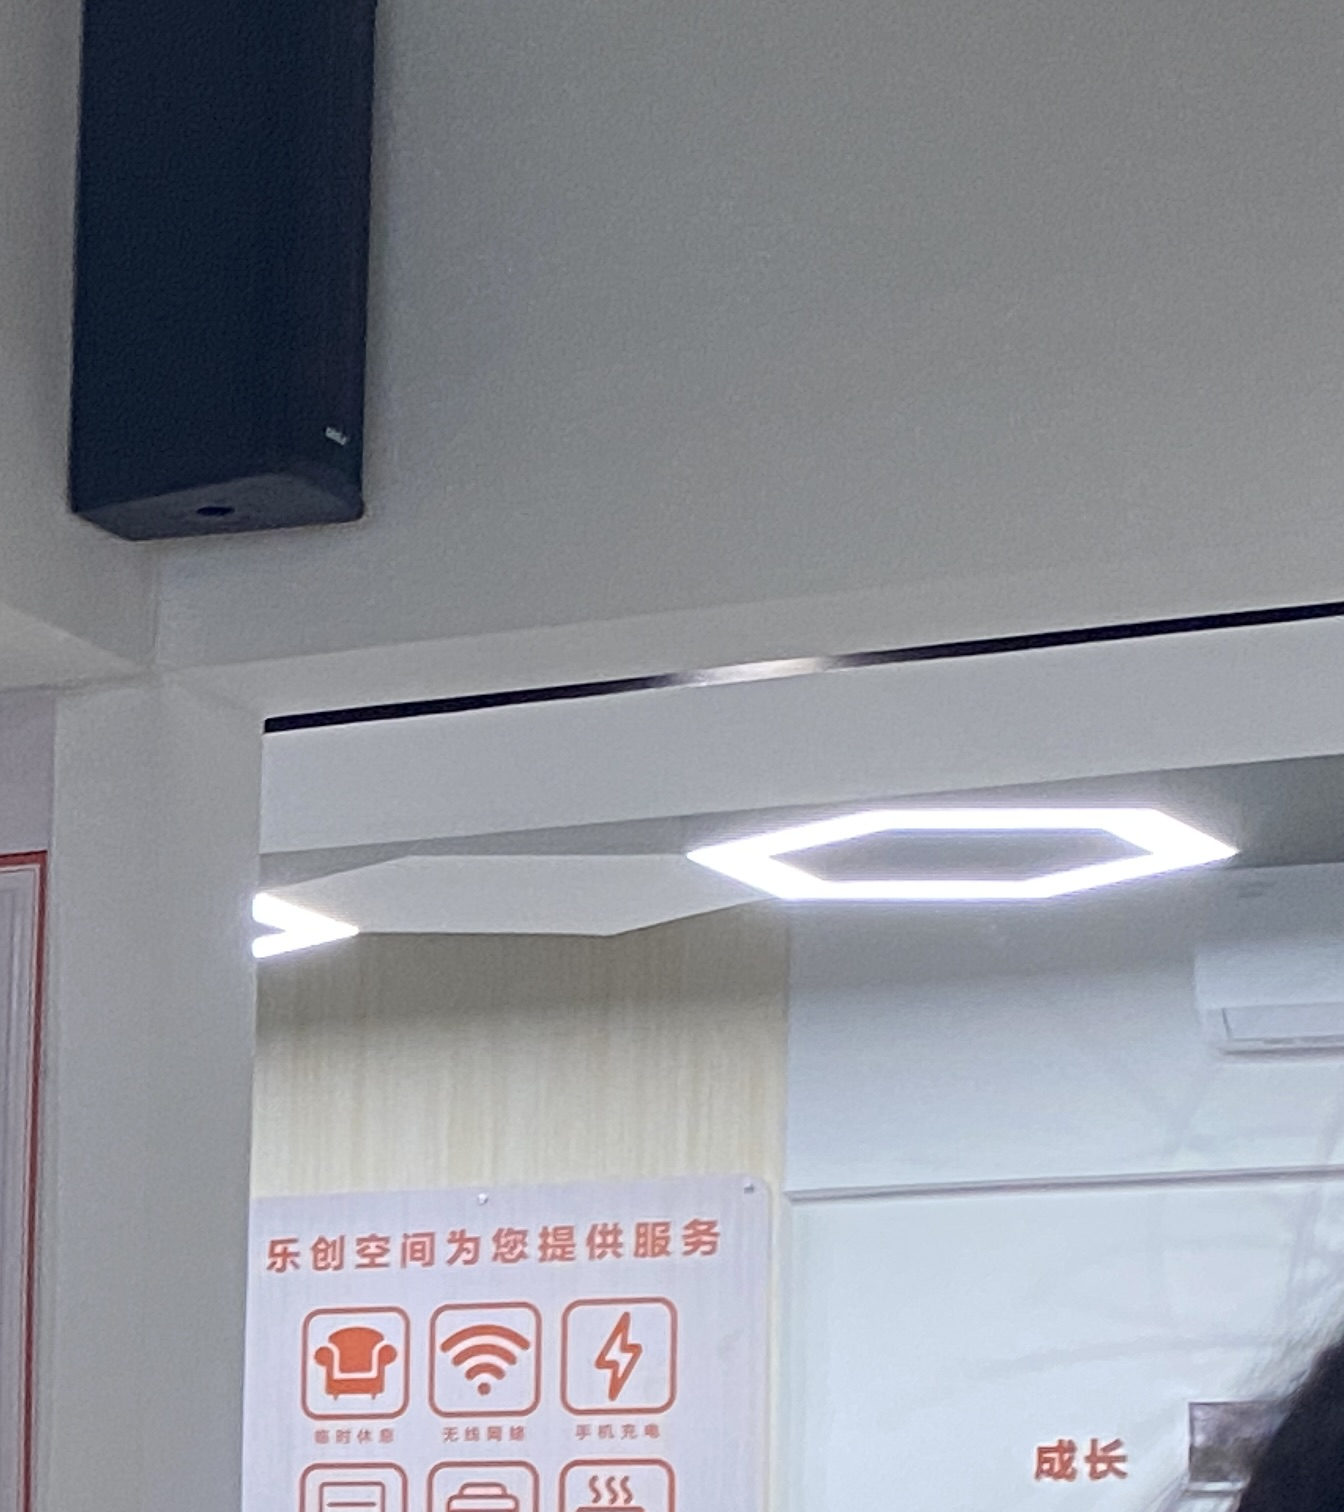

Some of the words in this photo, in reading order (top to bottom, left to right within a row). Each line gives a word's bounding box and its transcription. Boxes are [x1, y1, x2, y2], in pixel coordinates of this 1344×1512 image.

[266, 1219, 720, 1273] 乐创空间为您提供服务
[314, 1427, 395, 1445] 临时休息
[442, 1426, 526, 1442] 无线网络
[574, 1423, 660, 1440] 手机充电
[1034, 1439, 1128, 1481] 成长
